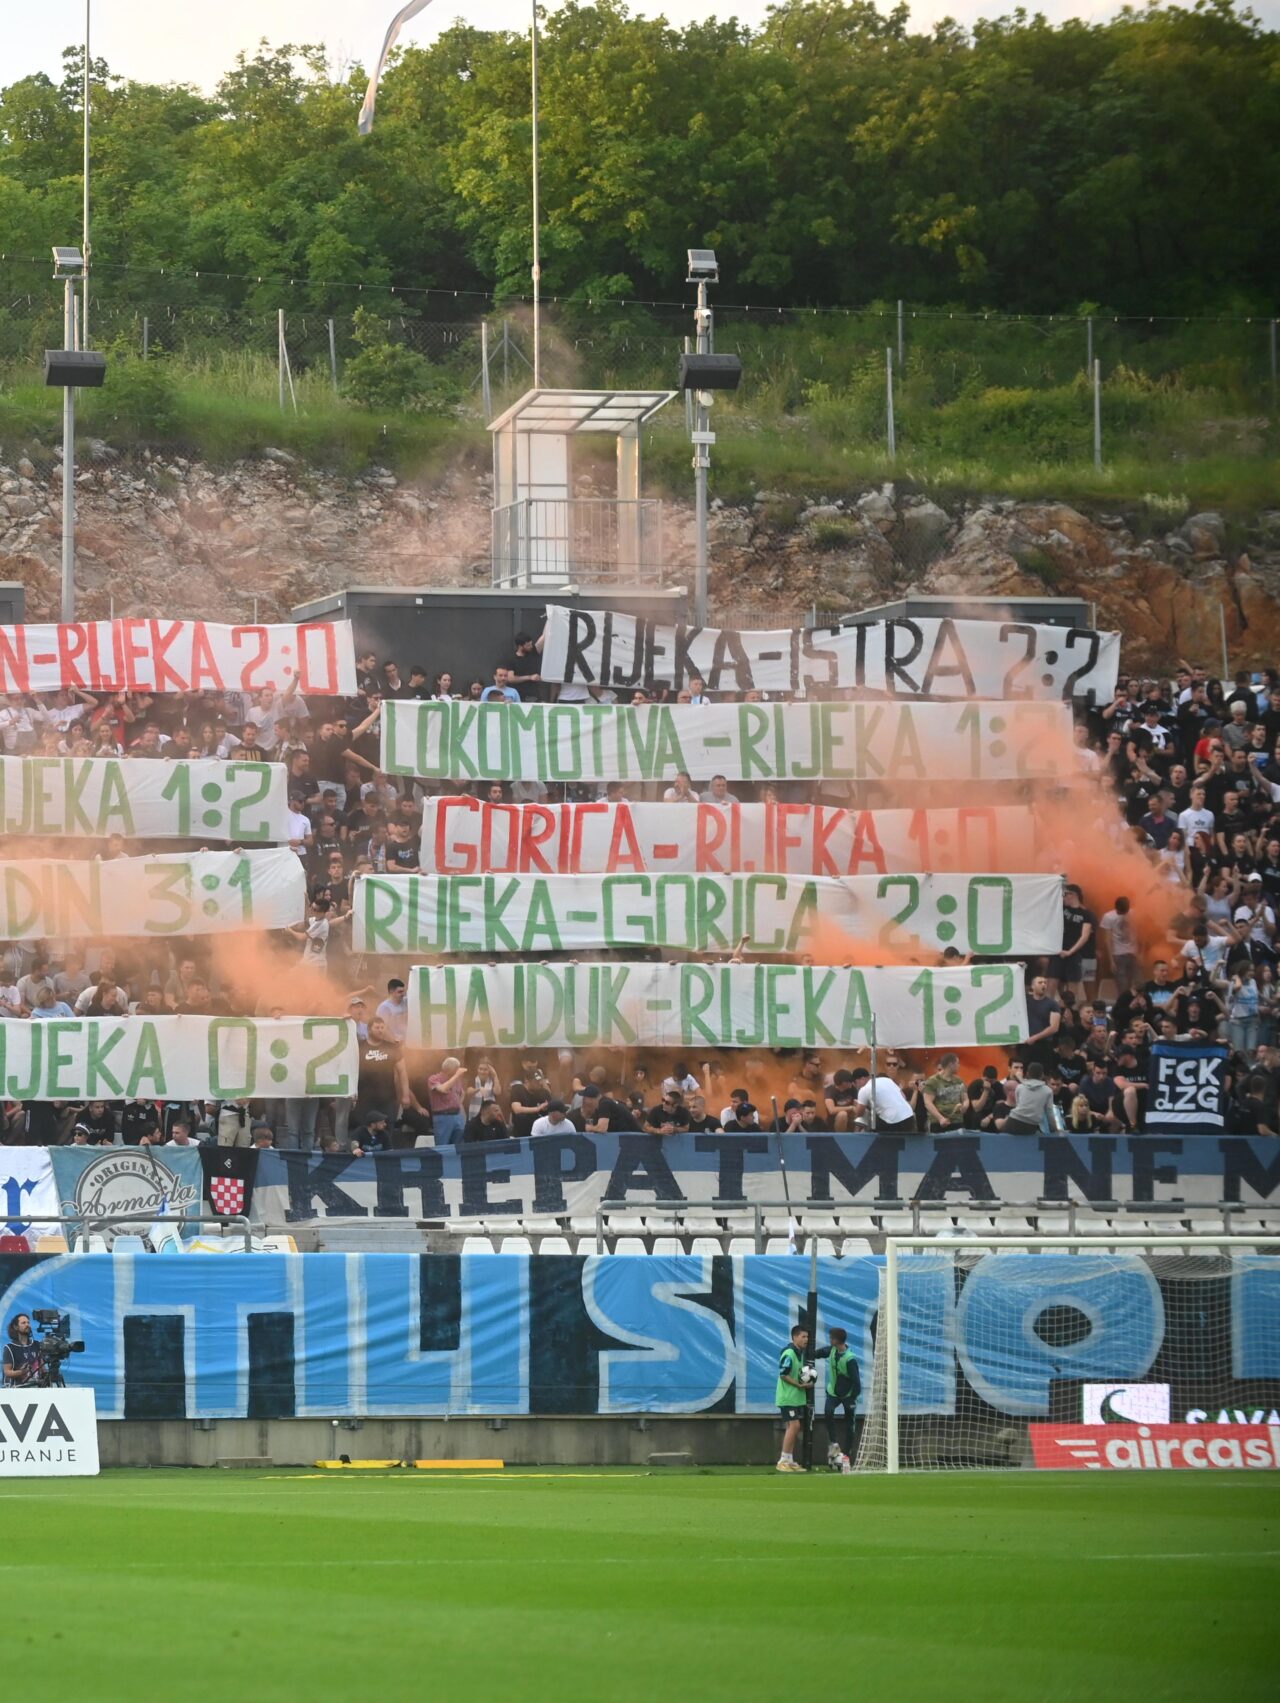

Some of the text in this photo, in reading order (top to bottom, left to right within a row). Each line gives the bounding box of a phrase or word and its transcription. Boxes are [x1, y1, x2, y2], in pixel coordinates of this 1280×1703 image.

[231, 623, 339, 695] 2:0
[161, 762, 272, 840] 1:2
[143, 859, 254, 934] 3:1
[877, 875, 1012, 953] 2:0
[908, 966, 1019, 1046] 1:2
[207, 1018, 349, 1098] 0:2
[1159, 1057, 1222, 1085] FCK
[280, 1133, 768, 1222] KREPAT
